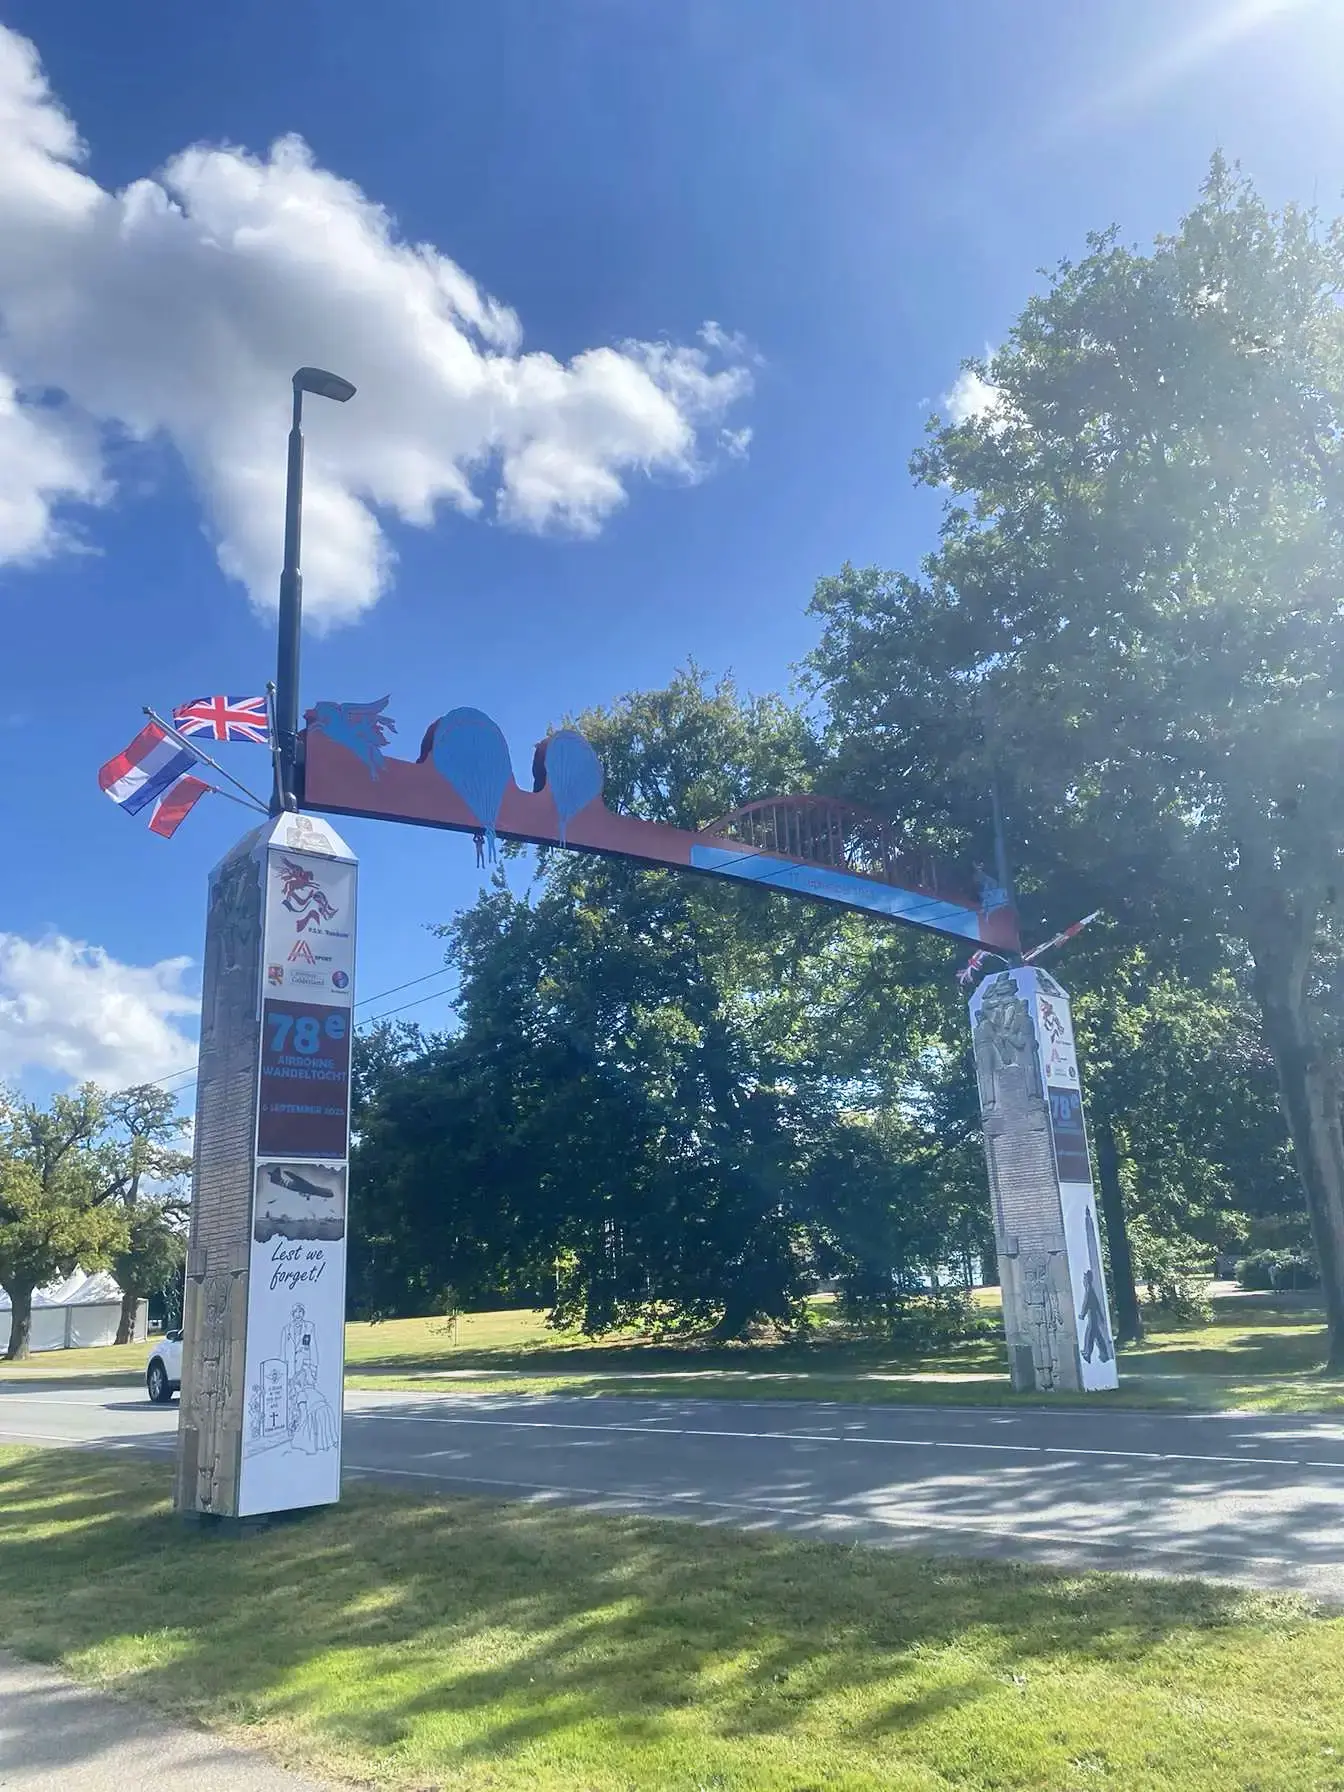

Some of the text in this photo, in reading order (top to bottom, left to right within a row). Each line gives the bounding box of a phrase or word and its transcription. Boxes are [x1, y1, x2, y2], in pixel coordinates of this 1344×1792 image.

[278, 1055, 336, 1070] AIRBORNE
[263, 1066, 346, 1082] WANDELTOCHT
[270, 1104, 322, 1115] SEPTEMBER
[271, 1240, 325, 1262] Lest we
[269, 1261, 327, 1291] forget!
